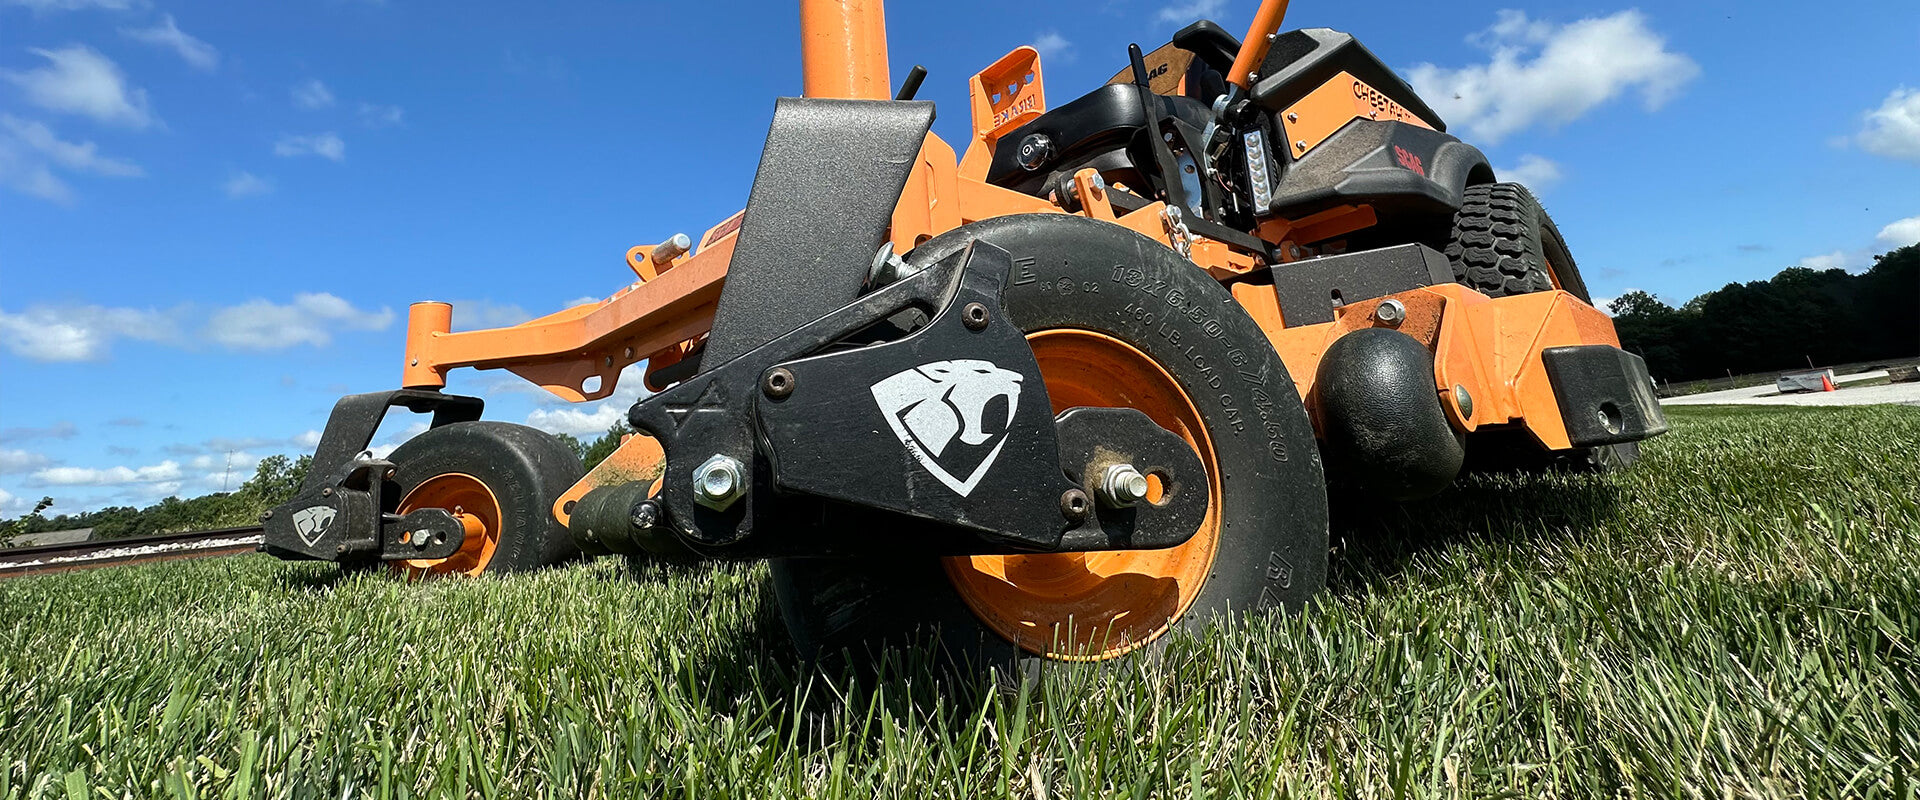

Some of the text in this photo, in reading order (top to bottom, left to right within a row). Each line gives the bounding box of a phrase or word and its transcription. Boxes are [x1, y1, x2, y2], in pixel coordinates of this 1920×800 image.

[1353, 81, 1403, 121] CHEETAH
[1394, 145, 1425, 176] SCAG
[1124, 302, 1155, 327] 460
[1184, 345, 1222, 390] LOAD
